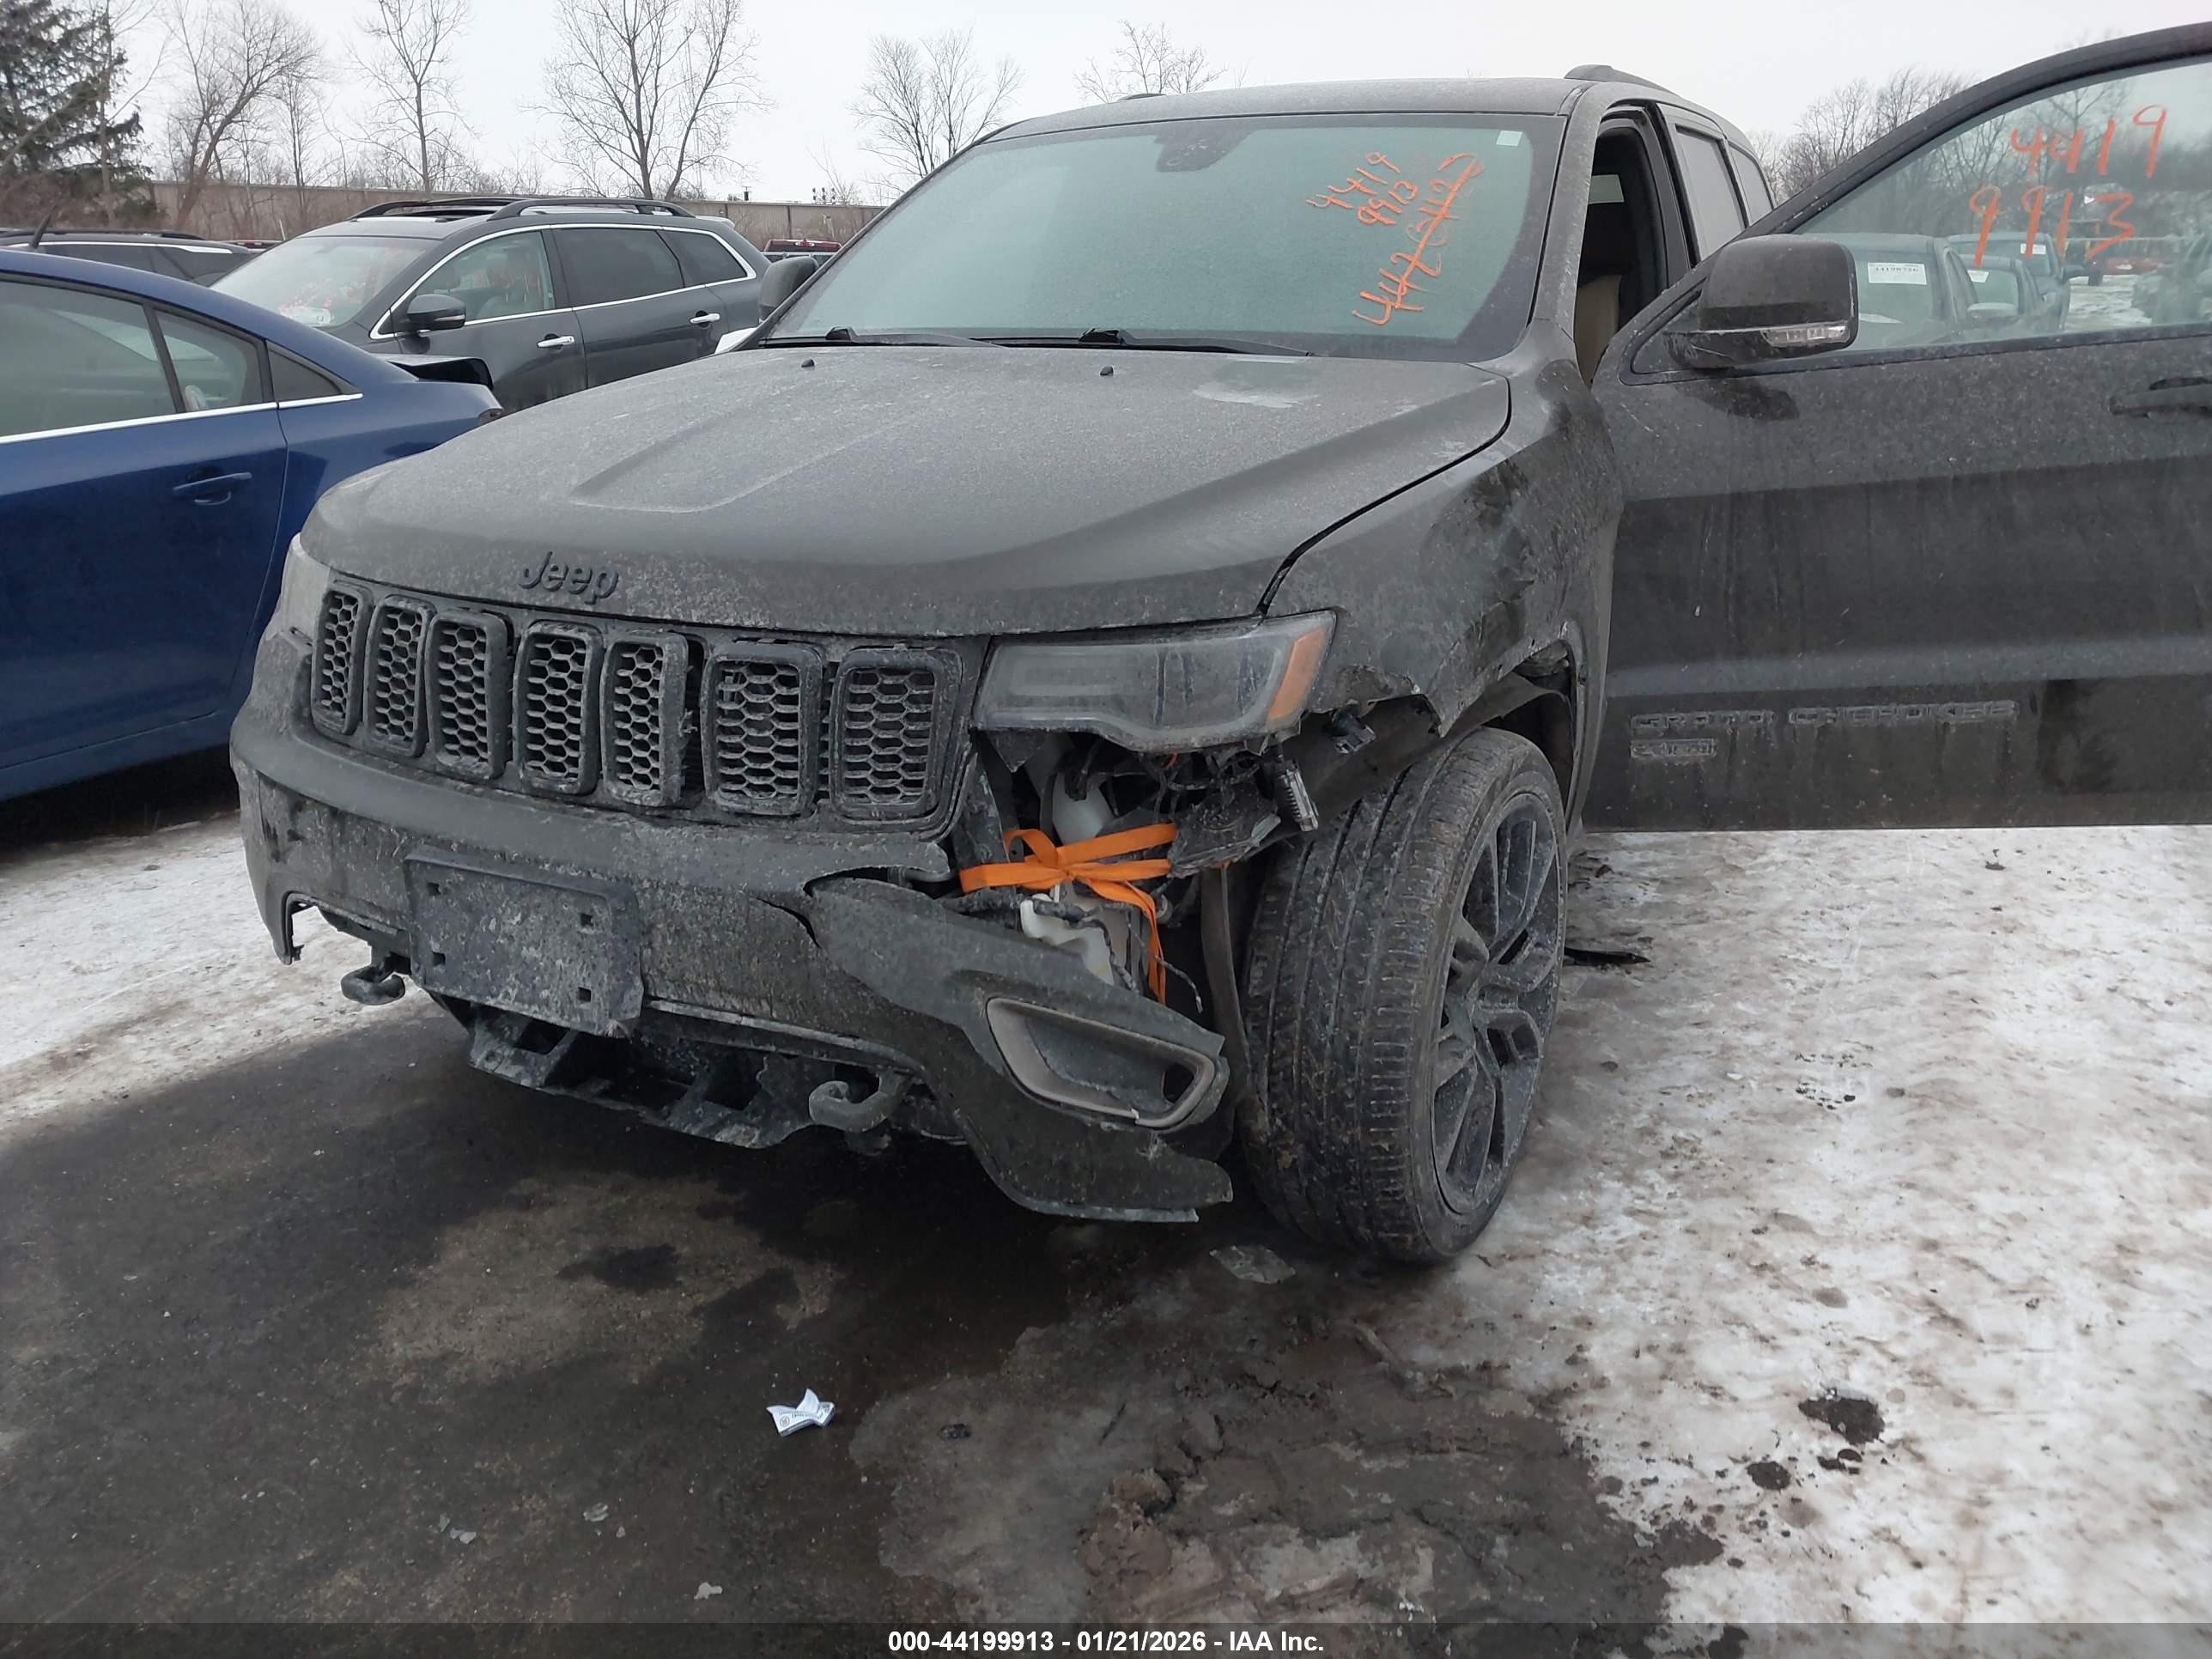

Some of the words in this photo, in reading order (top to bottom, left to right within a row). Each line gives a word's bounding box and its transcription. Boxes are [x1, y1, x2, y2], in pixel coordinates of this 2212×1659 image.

[2010, 104, 2167, 179] 4419
[1304, 151, 1401, 209] 4419
[1969, 185, 2136, 267] 9913
[519, 550, 619, 605] Jeep
